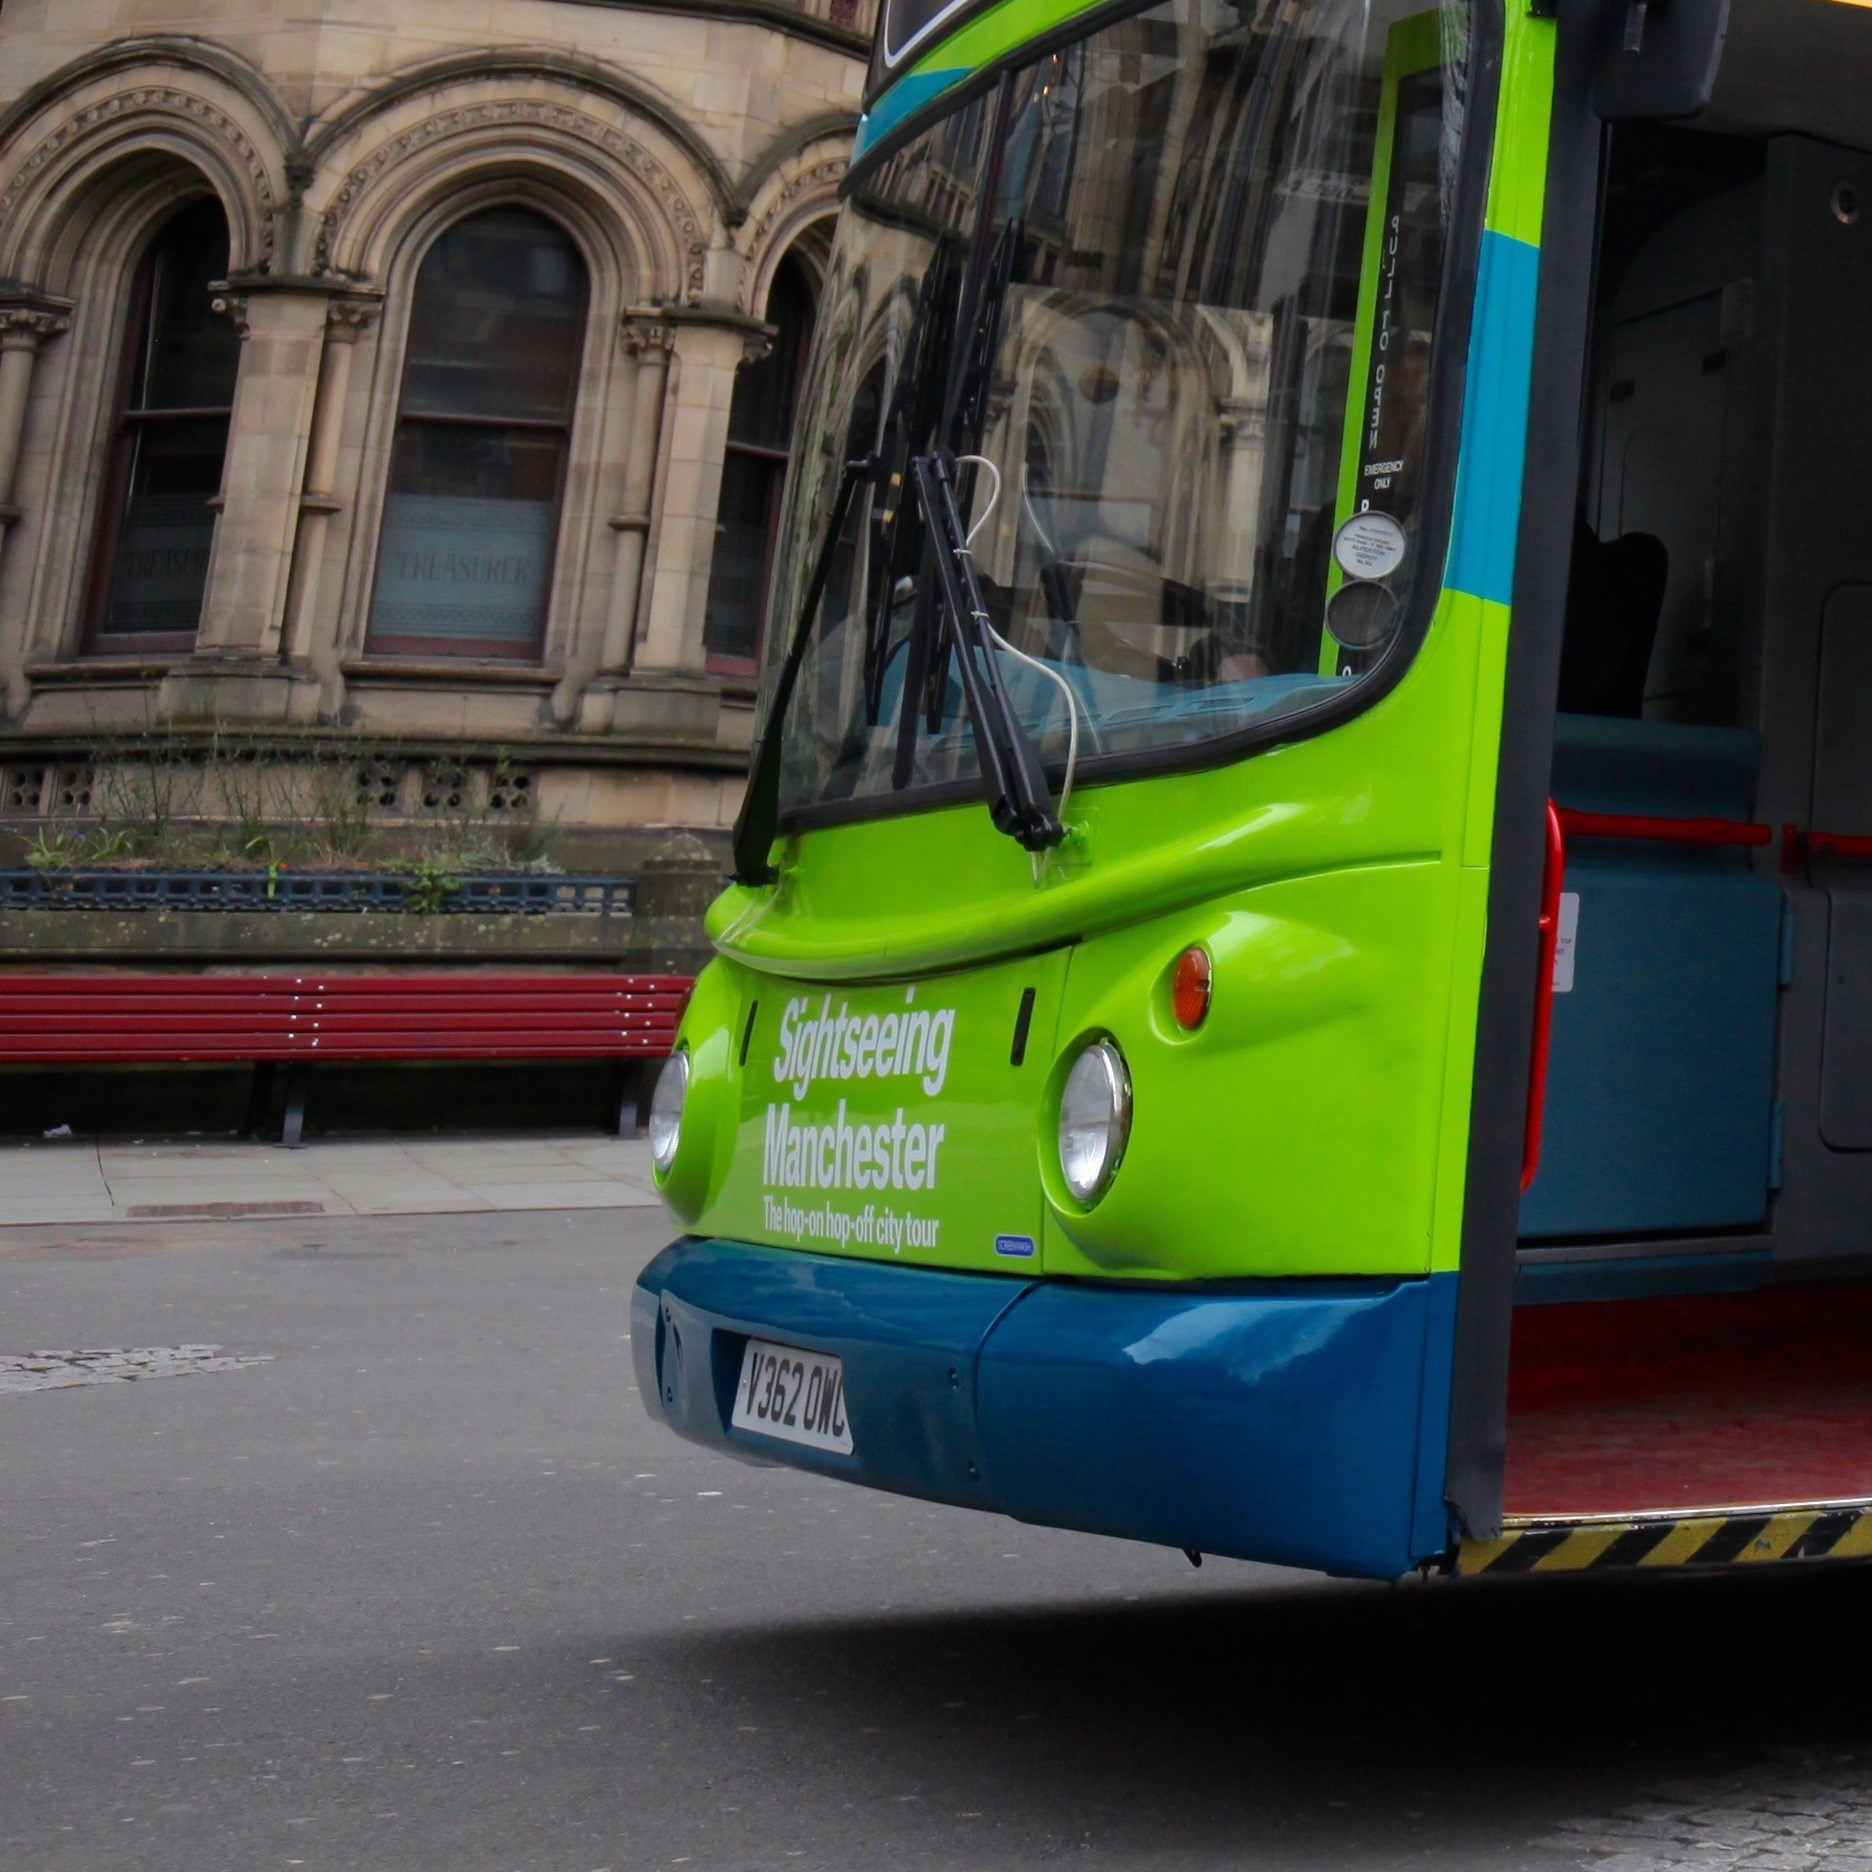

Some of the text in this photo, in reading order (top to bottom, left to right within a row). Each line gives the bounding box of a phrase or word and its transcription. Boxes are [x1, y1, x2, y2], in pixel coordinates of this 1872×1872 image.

[1364, 460, 1404, 476] EMERGENCY
[1374, 477, 1391, 490] ONLY
[773, 985, 956, 1101] Sightseeing
[762, 1098, 945, 1190] Manchester
[763, 1194, 939, 1254] The hop-on hop-off city tour
[746, 1351, 804, 1426] V362
